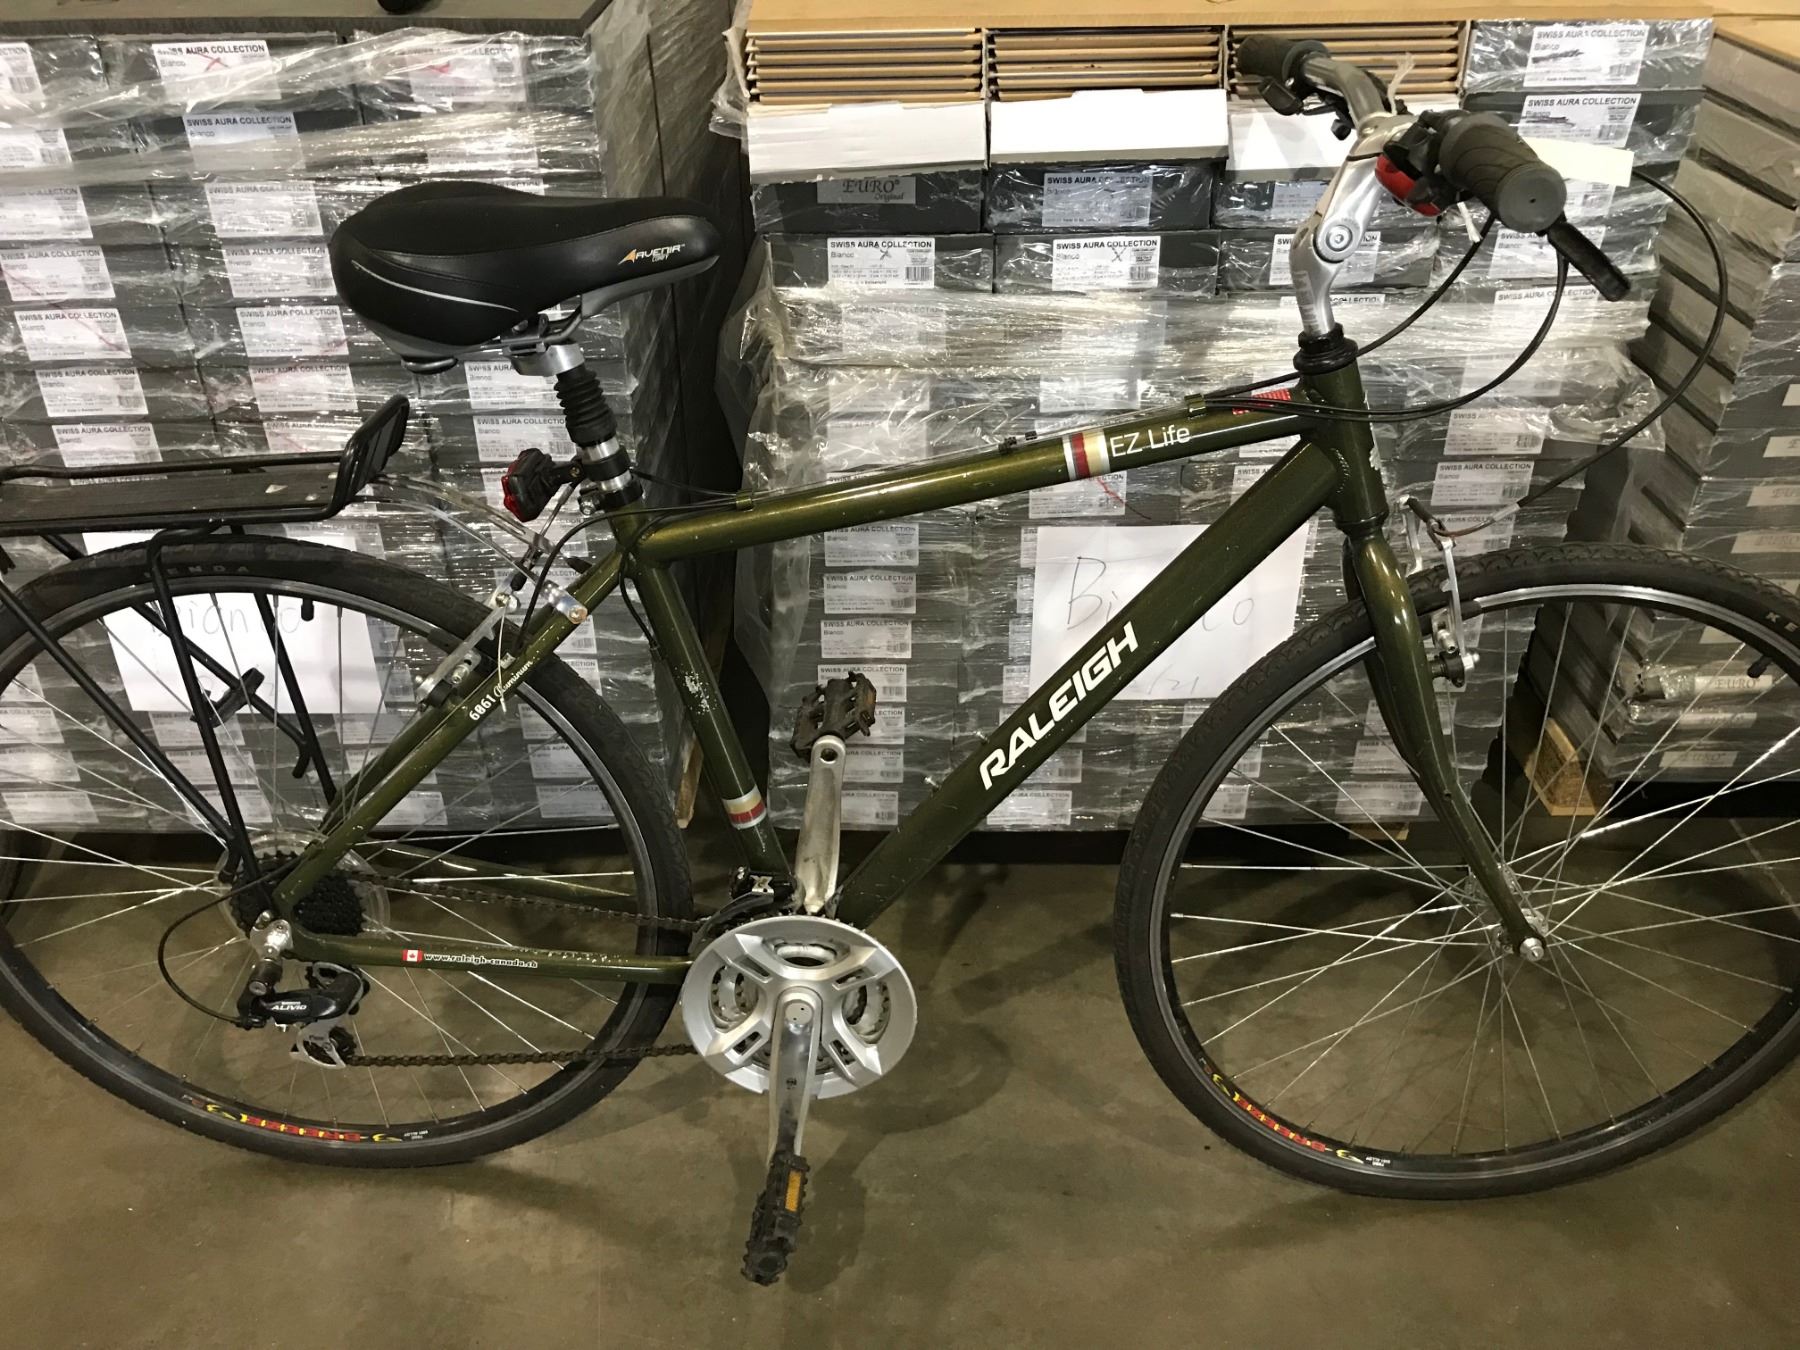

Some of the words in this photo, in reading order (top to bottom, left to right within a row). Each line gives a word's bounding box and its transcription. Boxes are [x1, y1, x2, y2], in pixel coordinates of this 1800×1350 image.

[1536, 30, 1564, 39] SWISS
[1591, 29, 1645, 38] COLLECTION
[185, 45, 209, 55] AURA
[210, 44, 266, 54] COLLECTION
[1527, 99, 1555, 107] SWISS
[1556, 98, 1581, 106] AURA
[1582, 97, 1637, 105] COLLECTION
[187, 116, 214, 127] SWISS
[214, 115, 238, 126] AURA
[239, 115, 292, 125] COLLECTION
[1047, 176, 1073, 184] SWISS
[1074, 176, 1096, 184] AURA
[842, 179, 895, 193] EURO
[881, 240, 933, 248] COLLECTION
[1056, 242, 1082, 250] SWISS
[1083, 241, 1105, 249] AURA
[1106, 240, 1158, 248] COLLECTION
[18, 314, 43, 322] SWISS
[44, 313, 66, 321] AURA
[67, 311, 117, 320] COLLECTION
[266, 310, 288, 318] AURA
[289, 309, 340, 317] COLLECTION
[56, 427, 79, 435] SWISS
[80, 427, 103, 435] AURA
[103, 426, 151, 434] COLLECTION
[1109, 432, 1143, 457] EZ
[1148, 424, 1191, 450] Life
[979, 621, 1138, 790] RALEIGH
[271, 1004, 308, 1012] ALIVIO
